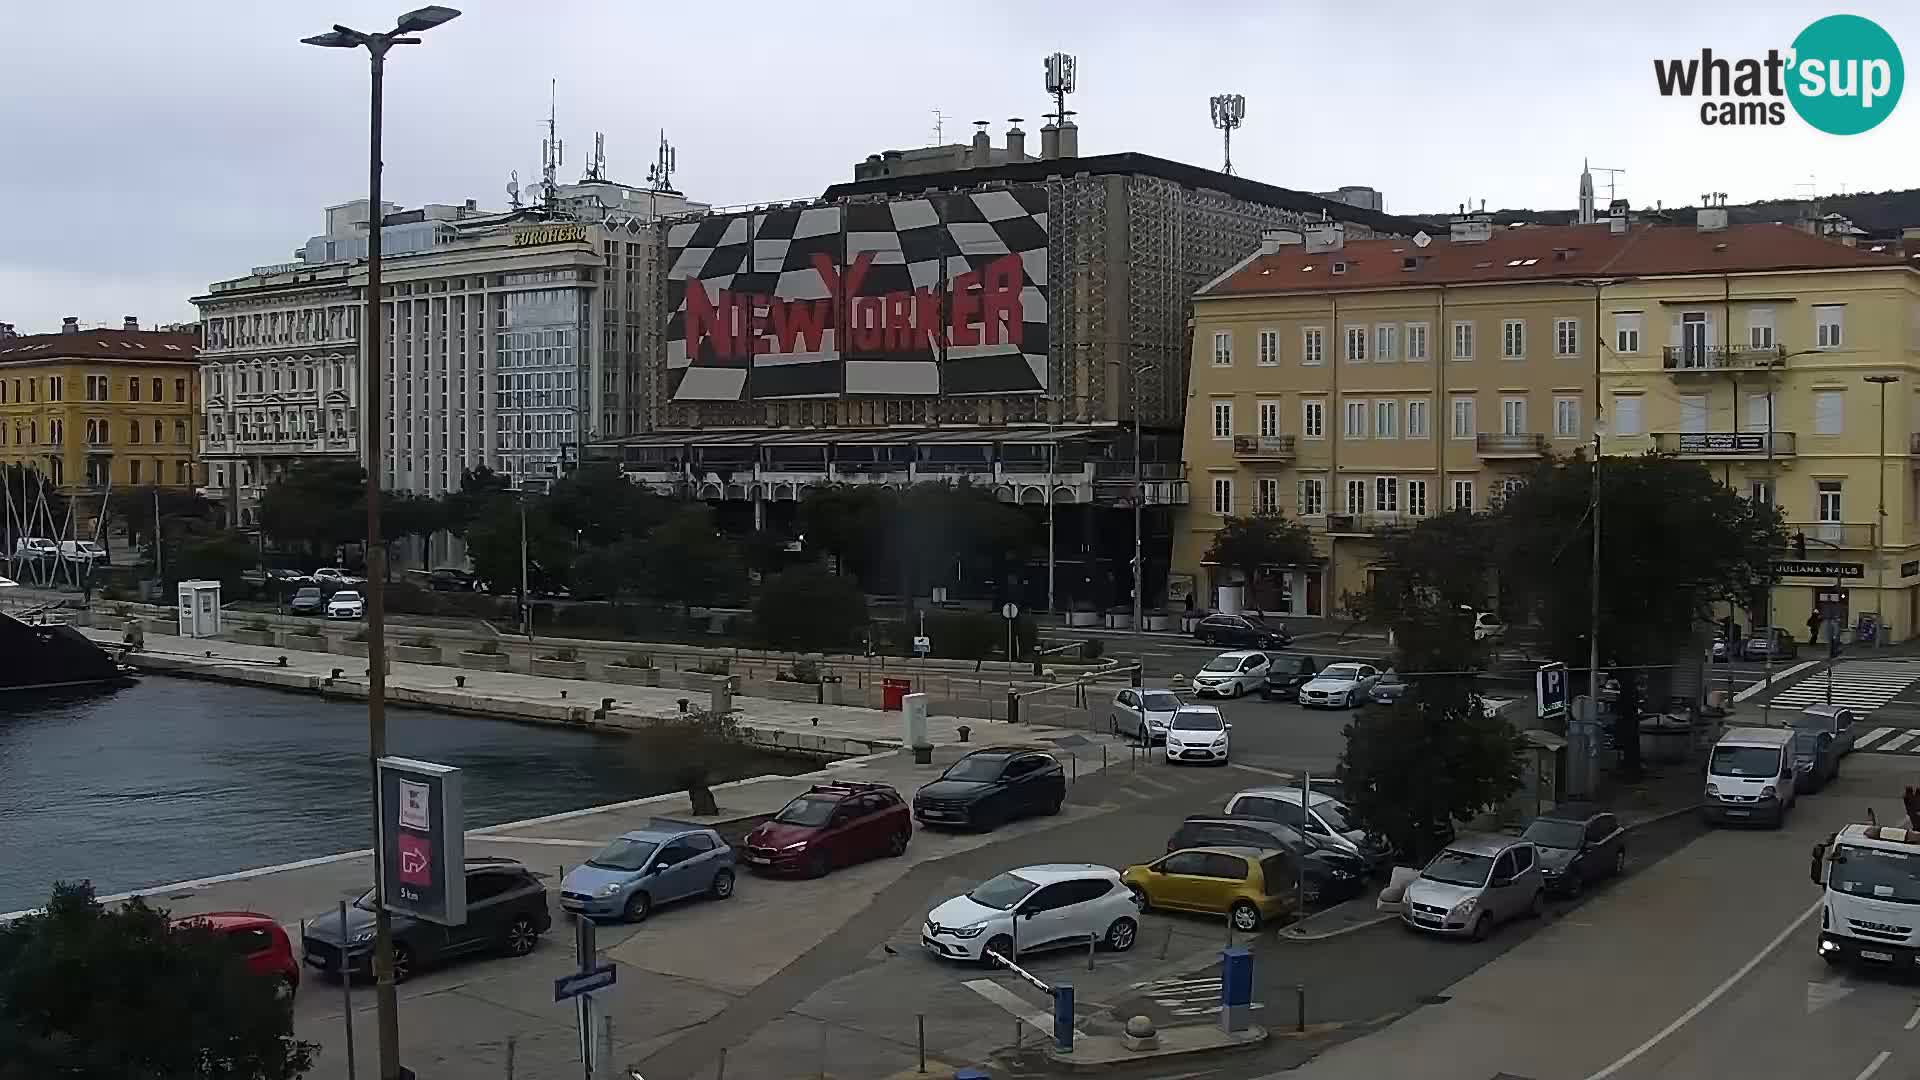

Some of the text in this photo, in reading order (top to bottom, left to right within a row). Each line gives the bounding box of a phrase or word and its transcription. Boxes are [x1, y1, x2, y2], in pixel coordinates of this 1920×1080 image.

[514, 226, 586, 245] EUROHERC
[685, 252, 1023, 361] NEW YORKER
[1776, 565, 1858, 575] JULIANA NAILS
[1548, 670, 1559, 693] P
